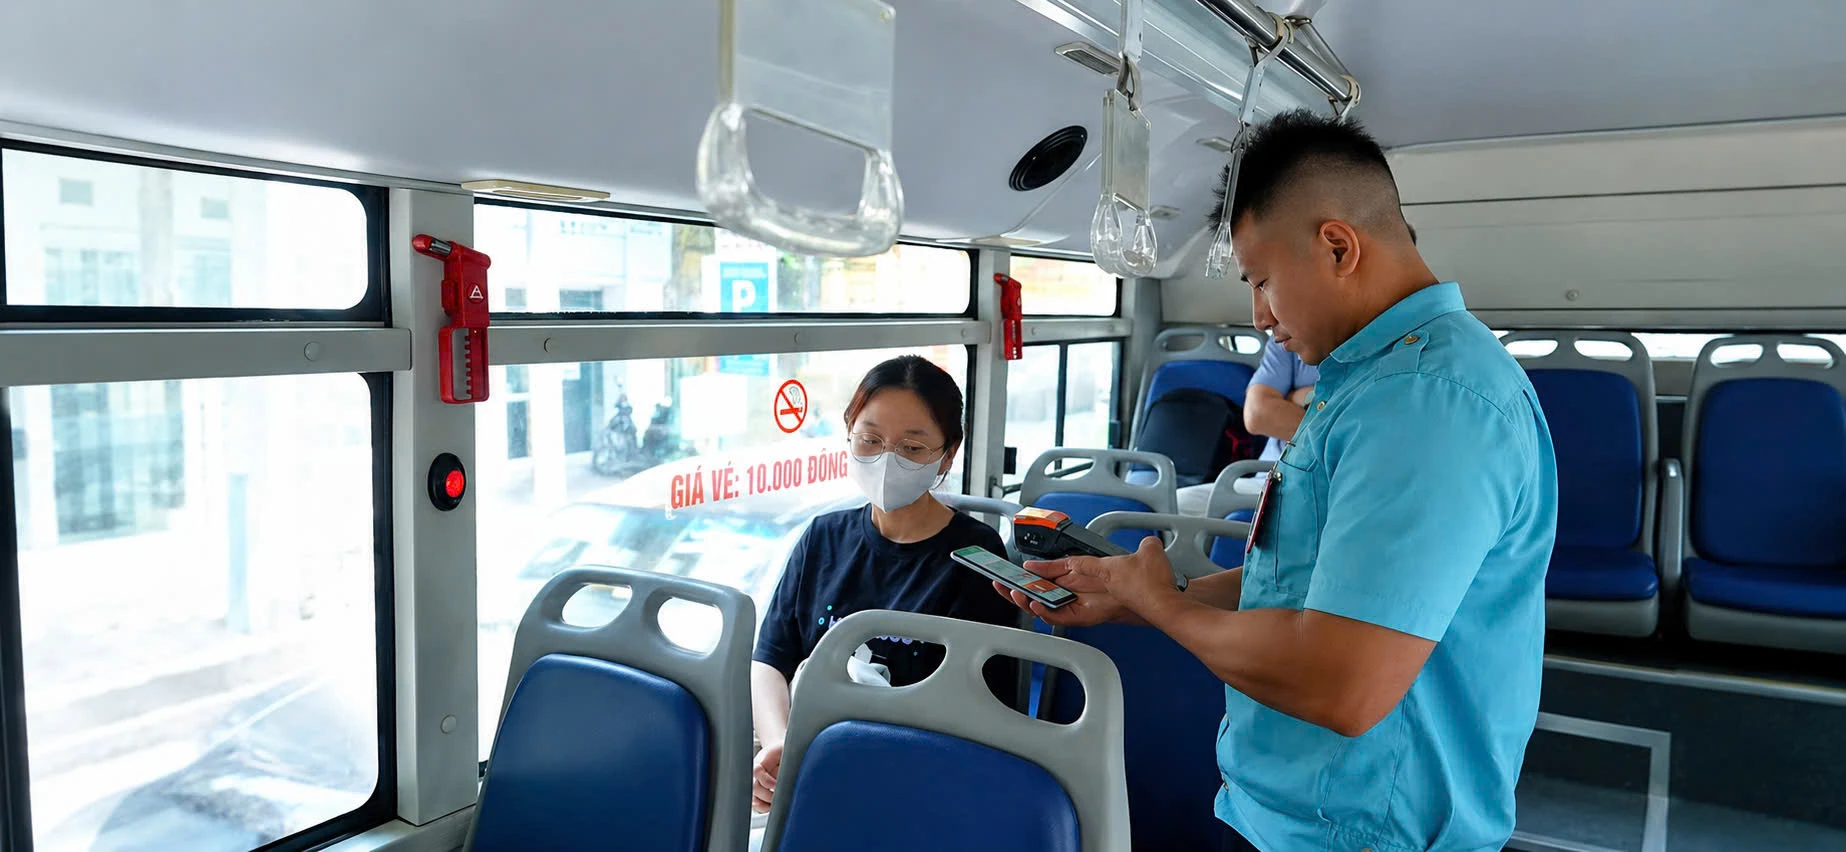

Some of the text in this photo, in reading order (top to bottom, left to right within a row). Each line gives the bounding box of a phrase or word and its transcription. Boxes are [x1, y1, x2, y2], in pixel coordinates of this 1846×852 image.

[732, 280, 756, 313] P
[671, 465, 705, 509] GIÁ
[711, 461, 739, 502] VÉ:
[747, 458, 803, 495] 10.000
